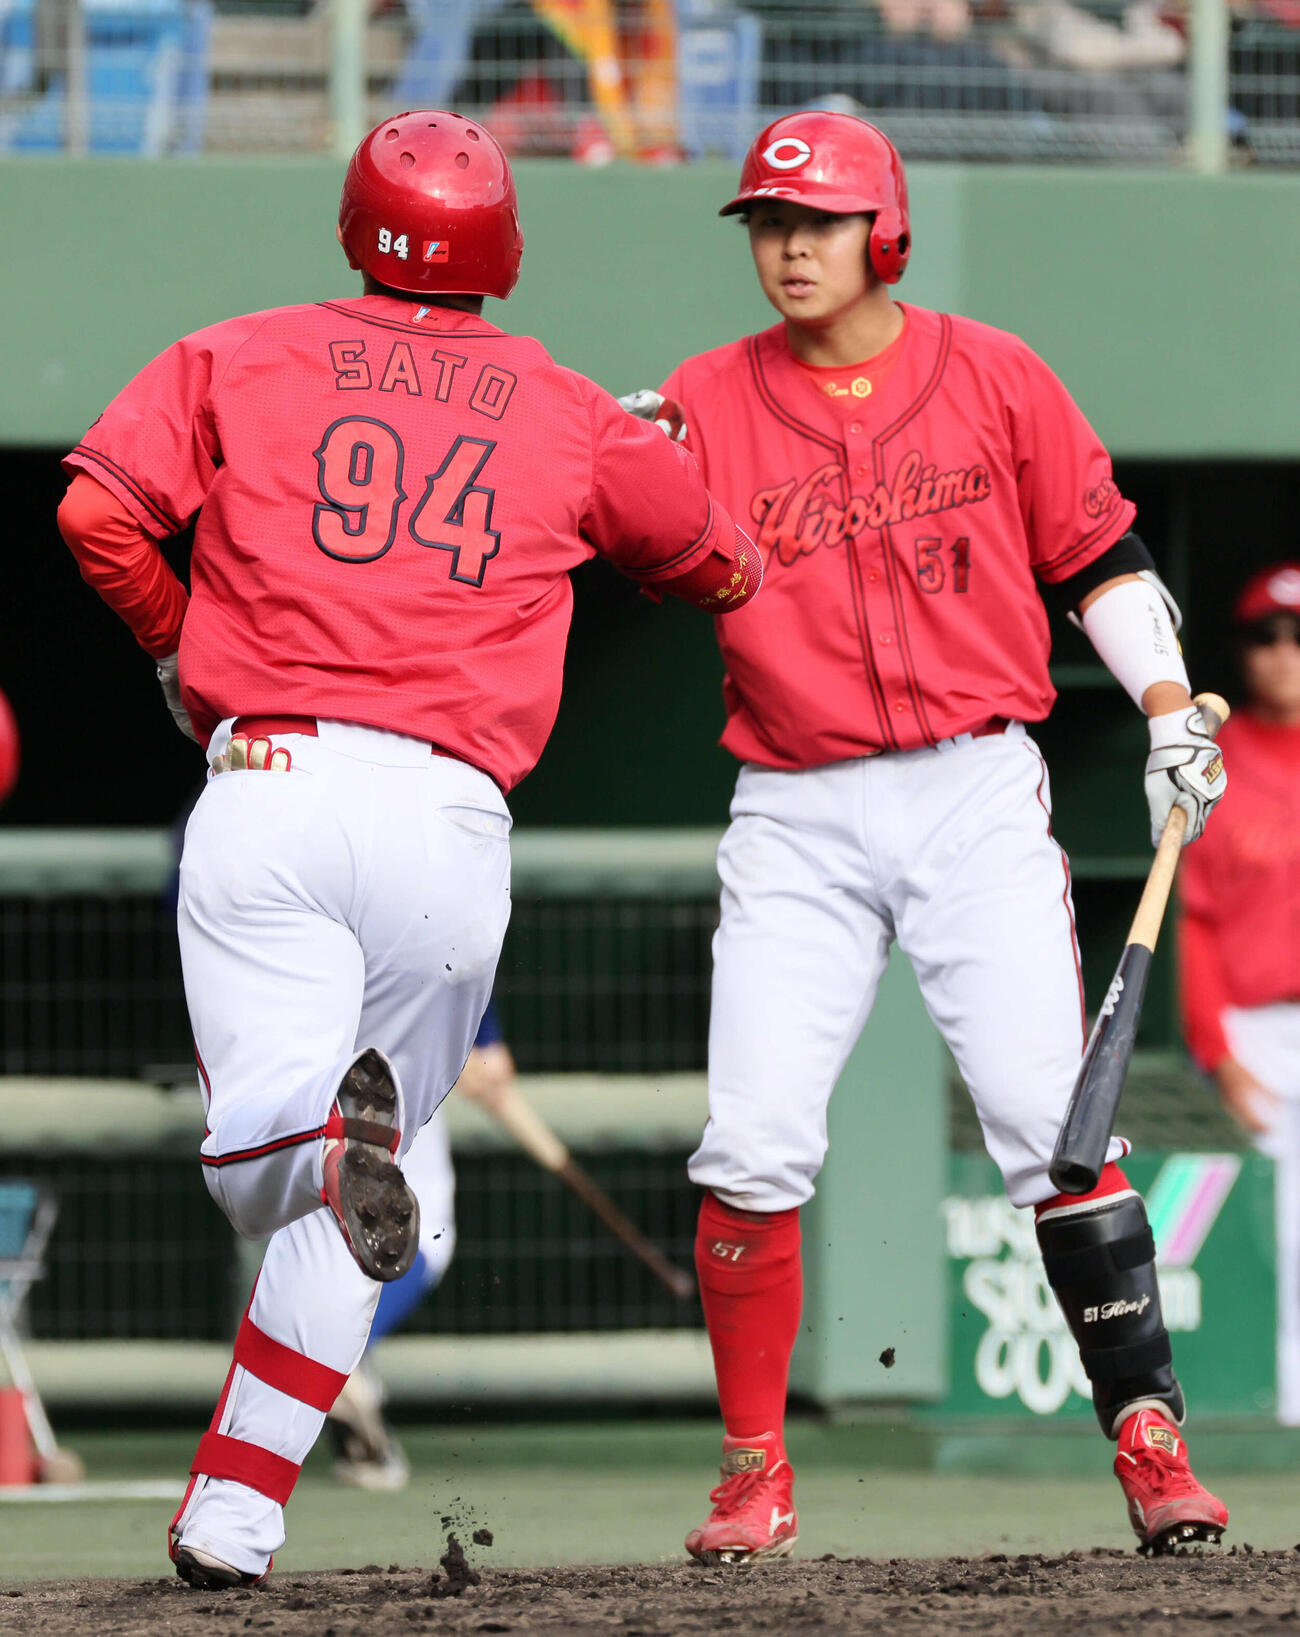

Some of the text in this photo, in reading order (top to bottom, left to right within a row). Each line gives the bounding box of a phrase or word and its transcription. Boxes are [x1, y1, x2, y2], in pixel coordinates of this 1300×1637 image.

[762, 137, 812, 170] C
[377, 227, 409, 261] 94
[329, 340, 518, 420] SATO
[312, 415, 501, 588] 94
[750, 450, 991, 567] Hiroshima
[914, 537, 971, 594] 51
[712, 1241, 746, 1262] 51
[1084, 1306, 1099, 1323] 51
